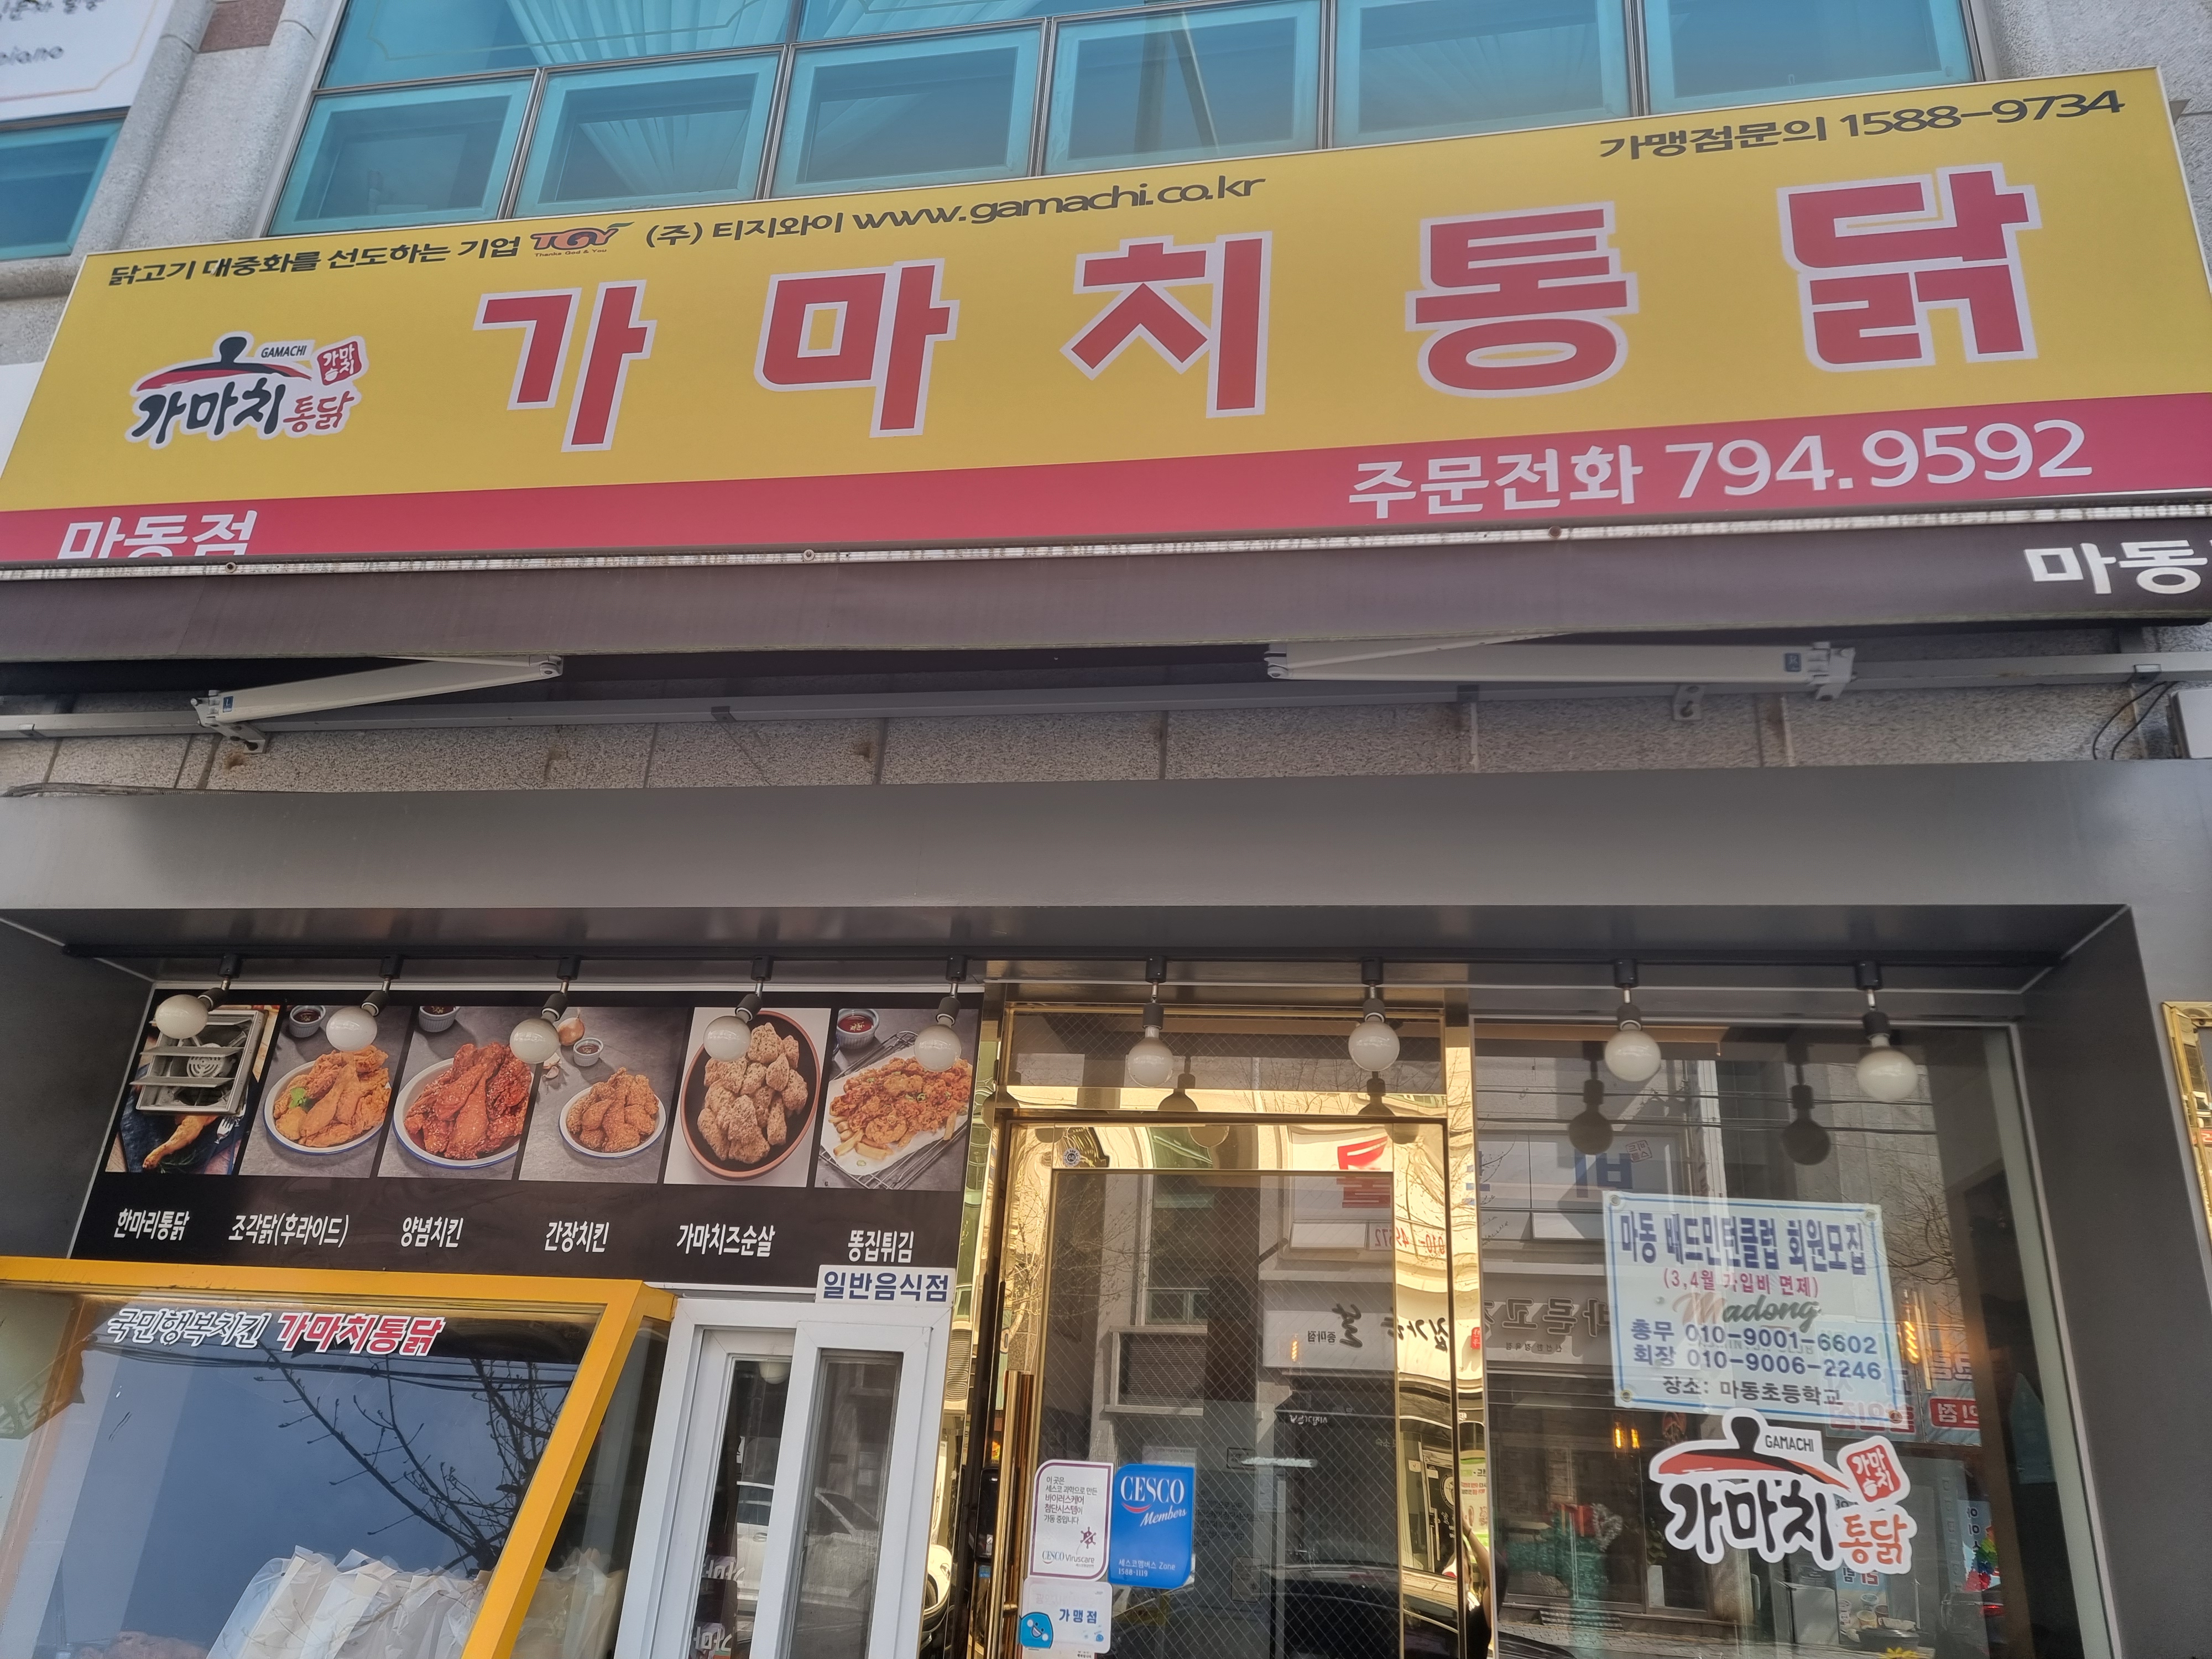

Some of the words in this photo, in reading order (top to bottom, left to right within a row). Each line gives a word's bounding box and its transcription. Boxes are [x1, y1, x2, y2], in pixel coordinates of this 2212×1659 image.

[1600, 116, 1827, 160] 가맹점문의
[1840, 90, 2125, 137] 1588-9734
[646, 222, 703, 248] (주)
[713, 213, 843, 240] 티지와이
[853, 175, 1266, 230] www.gamachi.co.kr
[108, 260, 196, 286] 닭고기
[202, 251, 322, 277] 대중화를
[327, 243, 451, 269] 선도하는
[457, 236, 520, 259] 기업
[473, 163, 2042, 452] 가마치통닭
[260, 345, 307, 358] GAMACHI
[131, 377, 286, 444] 가마치
[283, 390, 354, 432] 통닭
[1349, 445, 1643, 519] 주문전화
[1665, 419, 2093, 499] 794.9592
[57, 510, 258, 559] 마동점
[2023, 540, 2212, 594] 마동
[114, 1208, 190, 1241] 한마리통닭
[228, 1214, 349, 1248] 조각닭(후라이드)
[400, 1218, 464, 1249] 양념치킨
[545, 1221, 609, 1254] 간장치킨
[676, 1224, 775, 1258] 가마치즈순살
[848, 1230, 914, 1264] 똥집튀김
[1620, 1210, 1657, 1264] 마동
[1787, 1219, 1867, 1276] 회원모집
[823, 1271, 949, 1303] 일반음식점
[1663, 1267, 1715, 1291] (3,4월
[1780, 1275, 1819, 1298] 면제)
[107, 1308, 272, 1348] 국민행복치킨
[277, 1312, 445, 1357] 가마치통닭
[1631, 1318, 1674, 1341] 총무
[1686, 1324, 1877, 1355] 010-9001-6602
[1633, 1344, 1676, 1368] 회장
[1688, 1349, 1881, 1380] 010-9006-2246
[1662, 1375, 1709, 1396] 장소:
[1720, 1380, 1843, 1407] 마동초등학교
[1765, 1435, 1814, 1453] GAMACHI
[1045, 1485, 1062, 1493] 세스코
[1063, 1485, 1086, 1494] 과학으로
[1086, 1487, 1098, 1496] 만든
[1053, 1477, 1065, 1485] 곳은
[1120, 1475, 1185, 1505] CESCO
[1044, 1503, 1083, 1515] 첨단시스템이
[1045, 1494, 1085, 1505] 바이러스케어
[1140, 1505, 1187, 1527] Members
[1044, 1515, 1056, 1524] 가동
[1056, 1515, 1079, 1525] 중입니다
[1670, 1479, 1834, 1561] 가마치
[1839, 1513, 1907, 1566] 통닭
[1042, 1550, 1065, 1562] CESCO
[1065, 1553, 1095, 1564] Viruscare
[1118, 1559, 1156, 1570] 세스코멤버스
[1159, 1561, 1176, 1571] Zone
[1118, 1567, 1149, 1578] 1588-1119
[1058, 1608, 1098, 1624] 가맹점
